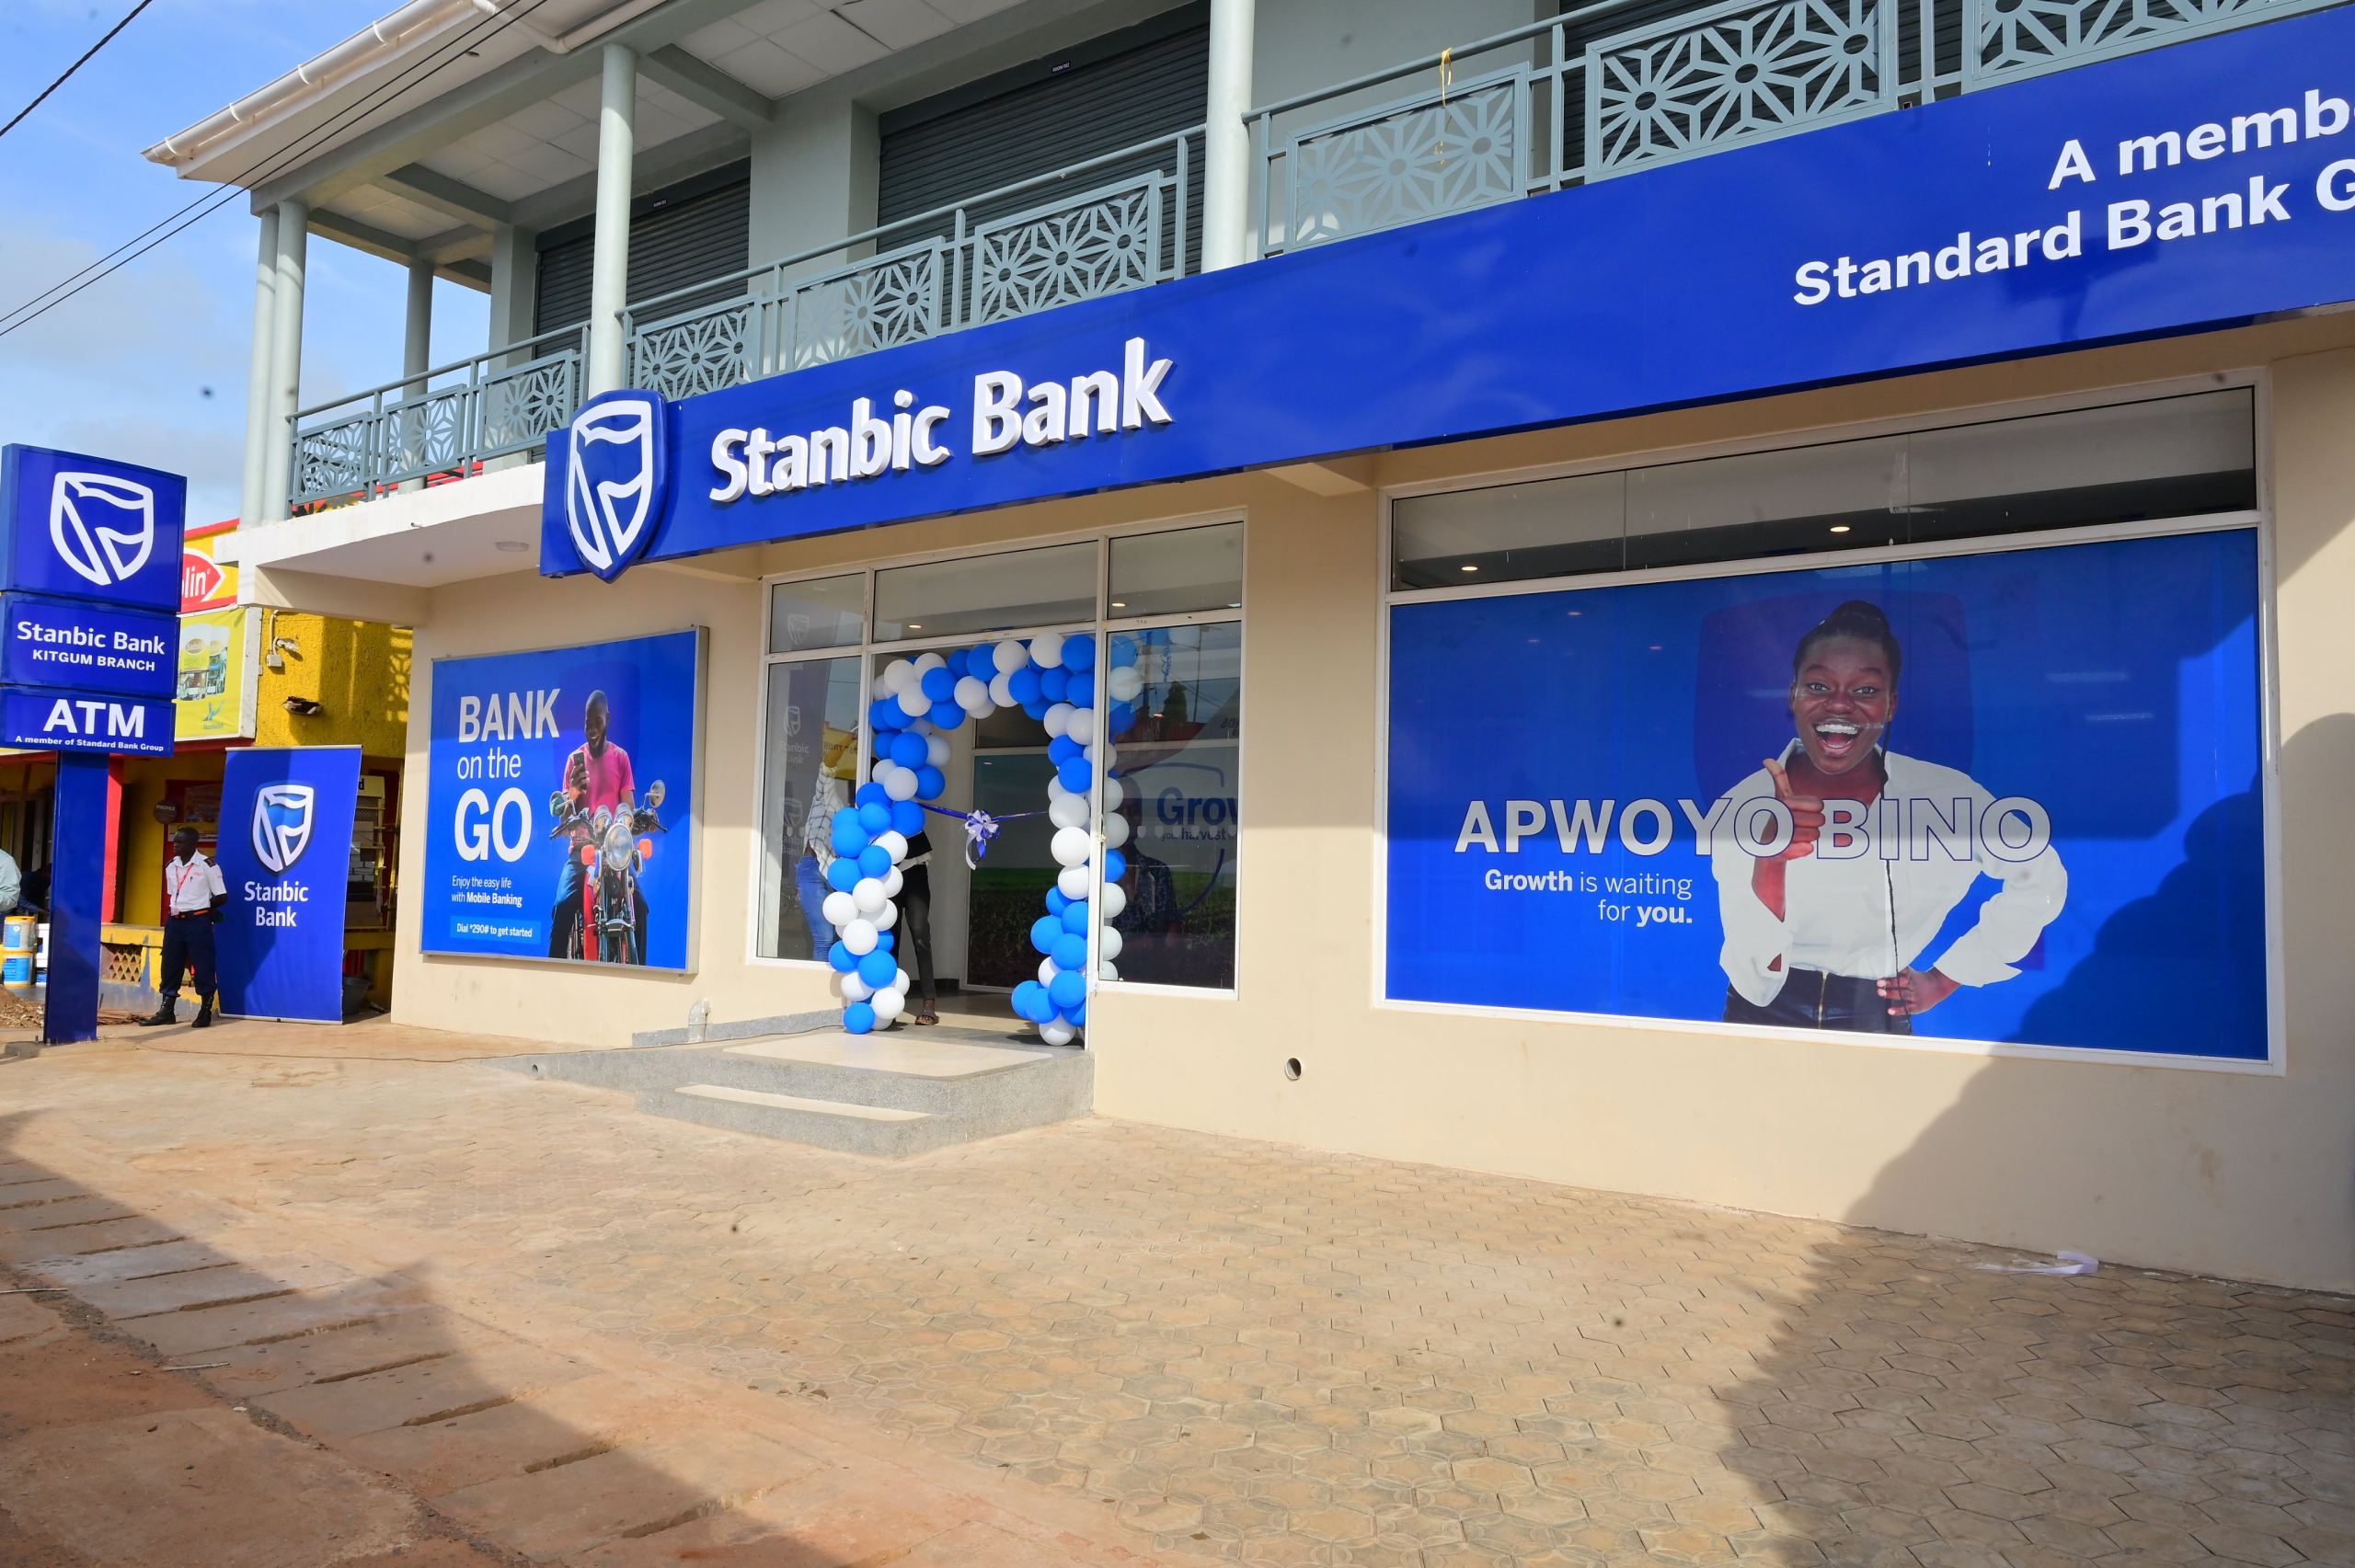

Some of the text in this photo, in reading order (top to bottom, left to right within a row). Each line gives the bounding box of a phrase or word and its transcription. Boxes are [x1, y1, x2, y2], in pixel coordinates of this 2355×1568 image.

[2048, 88, 2355, 190] A memb
[1793, 210, 2081, 305] Standard
[2107, 176, 2291, 251] Bank
[709, 337, 1174, 503] Stanbic Bank
[17, 621, 166, 655] Stanbic Bank
[32, 649, 155, 671] KITGUM BRANCH
[42, 698, 145, 738] ATM
[459, 689, 560, 743] BANK
[25, 737, 63, 745] member
[76, 738, 116, 749] Standard
[118, 741, 138, 750] Bank
[141, 743, 164, 752] Group
[457, 747, 522, 779] on the
[454, 787, 532, 862] GO
[1453, 795, 2051, 863] APWOYO BINO
[452, 876, 511, 890] Enjoy the easy life
[452, 892, 523, 908] with Mobile Banking
[1484, 869, 1693, 899] Growth is waiting
[244, 880, 308, 927] Stanbic Bank
[1597, 898, 1694, 927] for you.
[456, 923, 468, 933] Dial
[490, 925, 497, 934] to
[498, 927, 508, 936] get
[510, 928, 533, 937] started
